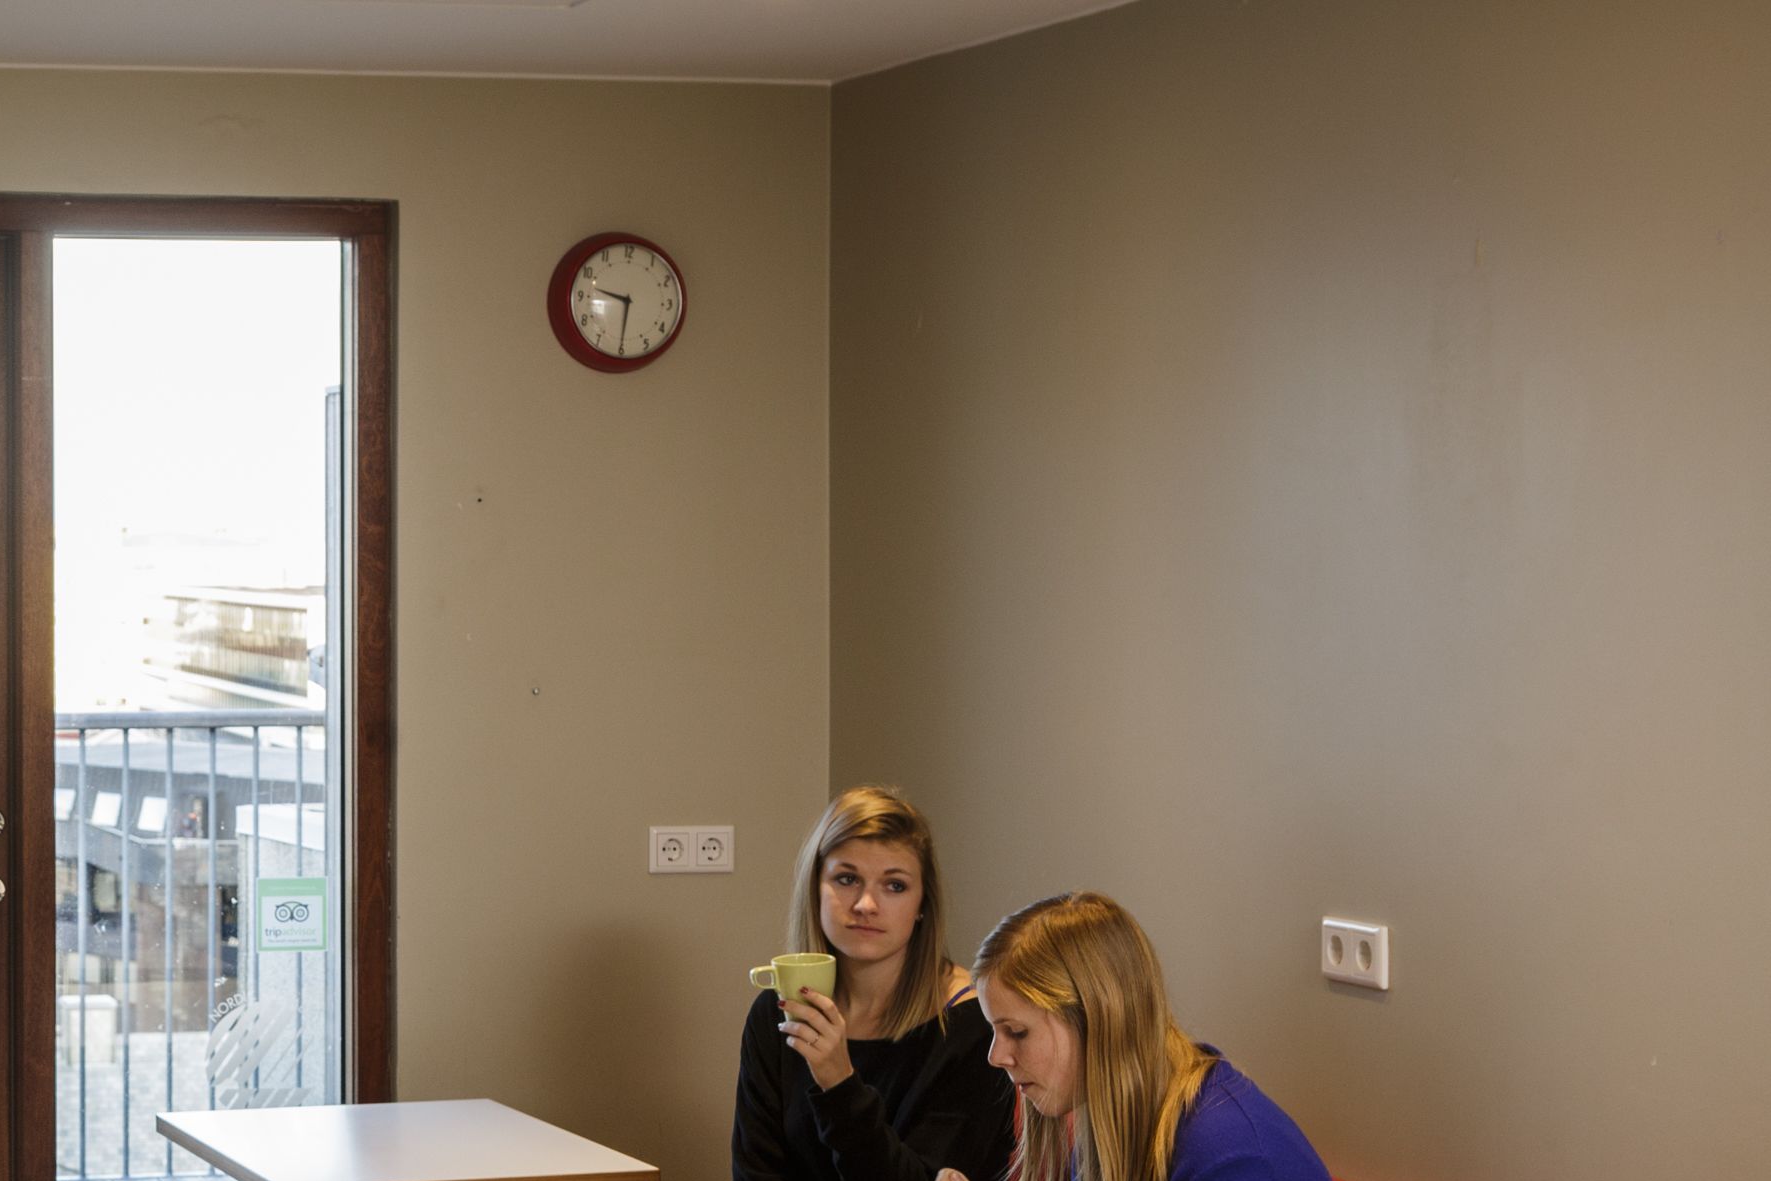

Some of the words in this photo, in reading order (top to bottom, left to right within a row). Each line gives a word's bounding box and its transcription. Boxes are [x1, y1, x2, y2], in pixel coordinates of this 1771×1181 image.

[602, 250, 609, 262] 11
[624, 245, 635, 259] 12
[650, 254, 655, 268] 1
[583, 265, 593, 279] 10
[663, 275, 670, 287] 2
[578, 290, 584, 302] 9
[666, 299, 673, 311] 3
[581, 314, 588, 326] 8
[658, 321, 665, 333] 4
[596, 334, 601, 348] 7
[643, 338, 649, 351] 5
[618, 343, 625, 355] 6
